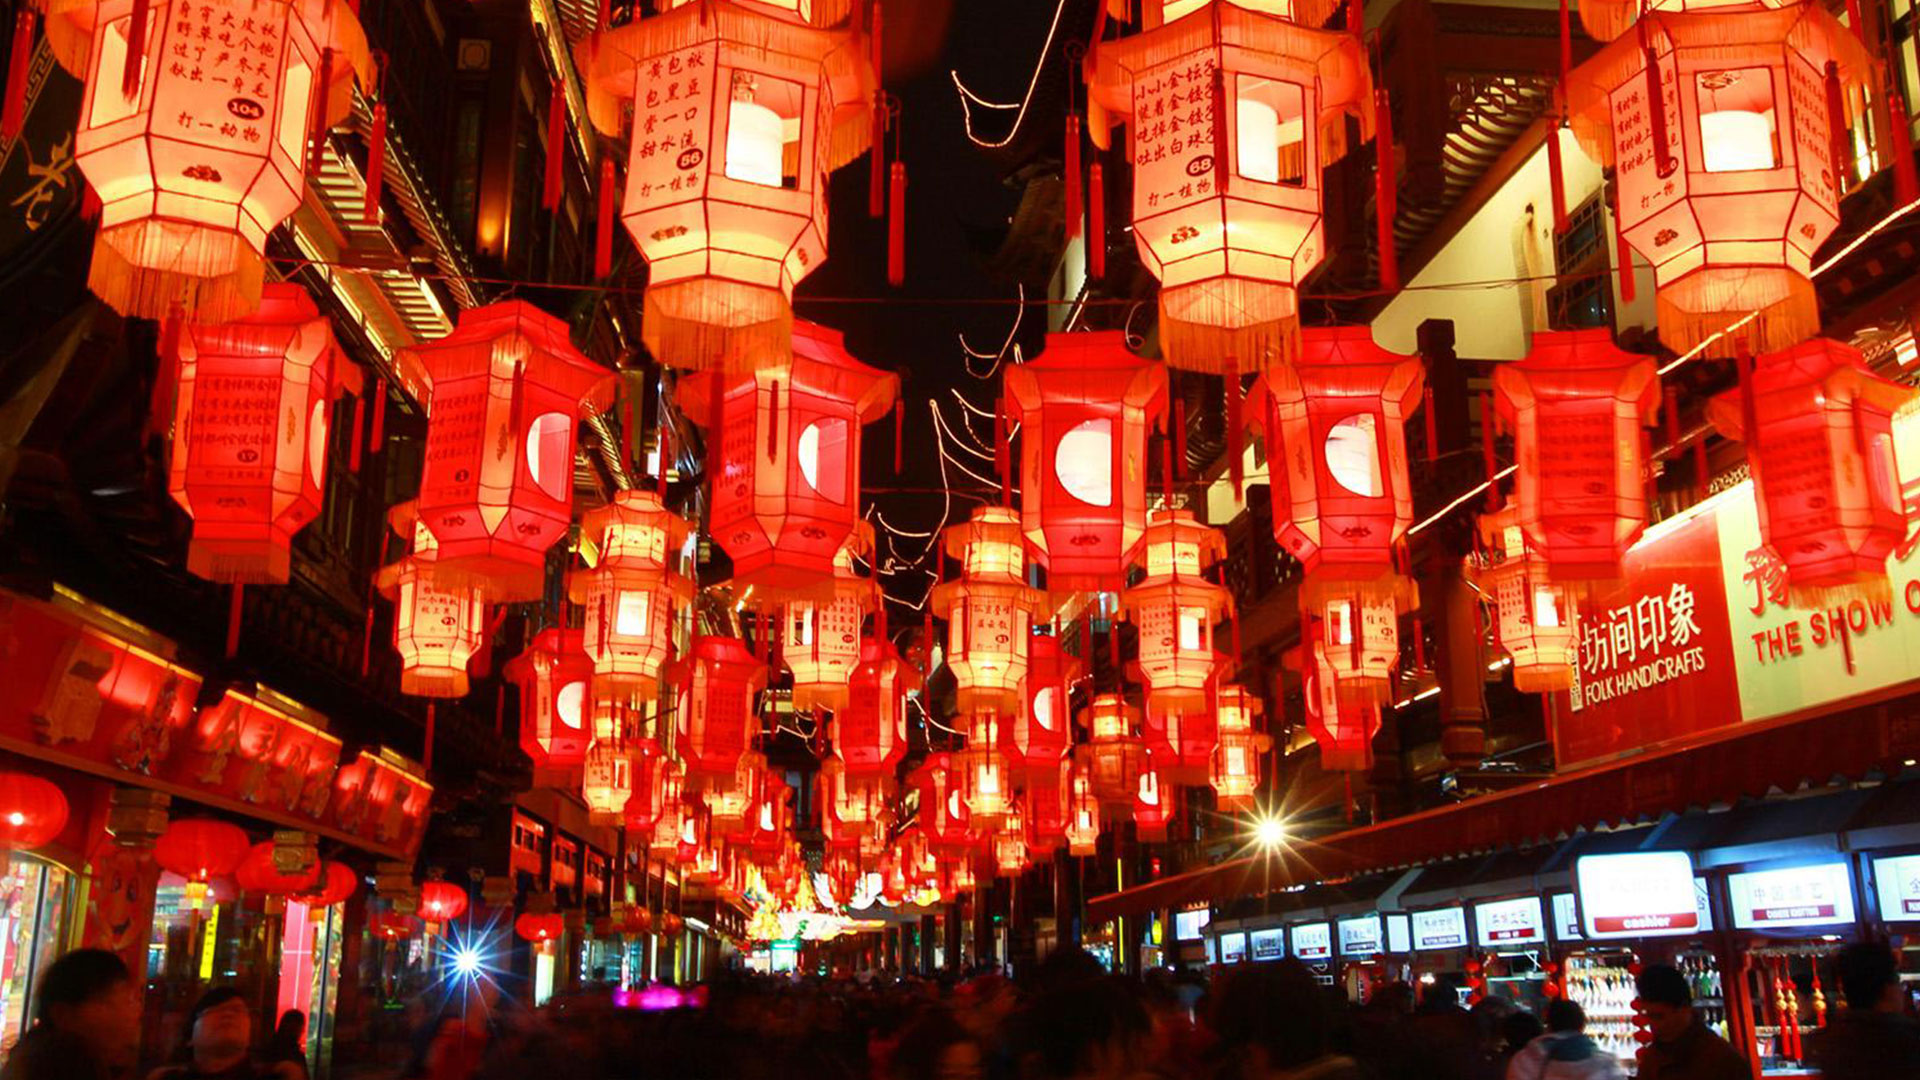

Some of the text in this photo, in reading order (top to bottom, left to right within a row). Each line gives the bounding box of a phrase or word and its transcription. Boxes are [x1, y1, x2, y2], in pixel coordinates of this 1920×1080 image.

[229, 100, 262, 118] 104
[178, 111, 261, 143] 打一动物
[640, 128, 697, 159] 甜水流
[1188, 157, 1213, 175] 68
[641, 172, 699, 198] 打一植物
[1147, 178, 1212, 208] 打一植物
[1581, 583, 1701, 676] 坊间印象
[1752, 620, 1803, 663] THE
[1809, 600, 1894, 645] SHOW
[1585, 676, 1617, 706] FOLK
[1616, 646, 1706, 697] HANDICRAFTS
[1623, 914, 1671, 930] cashier
